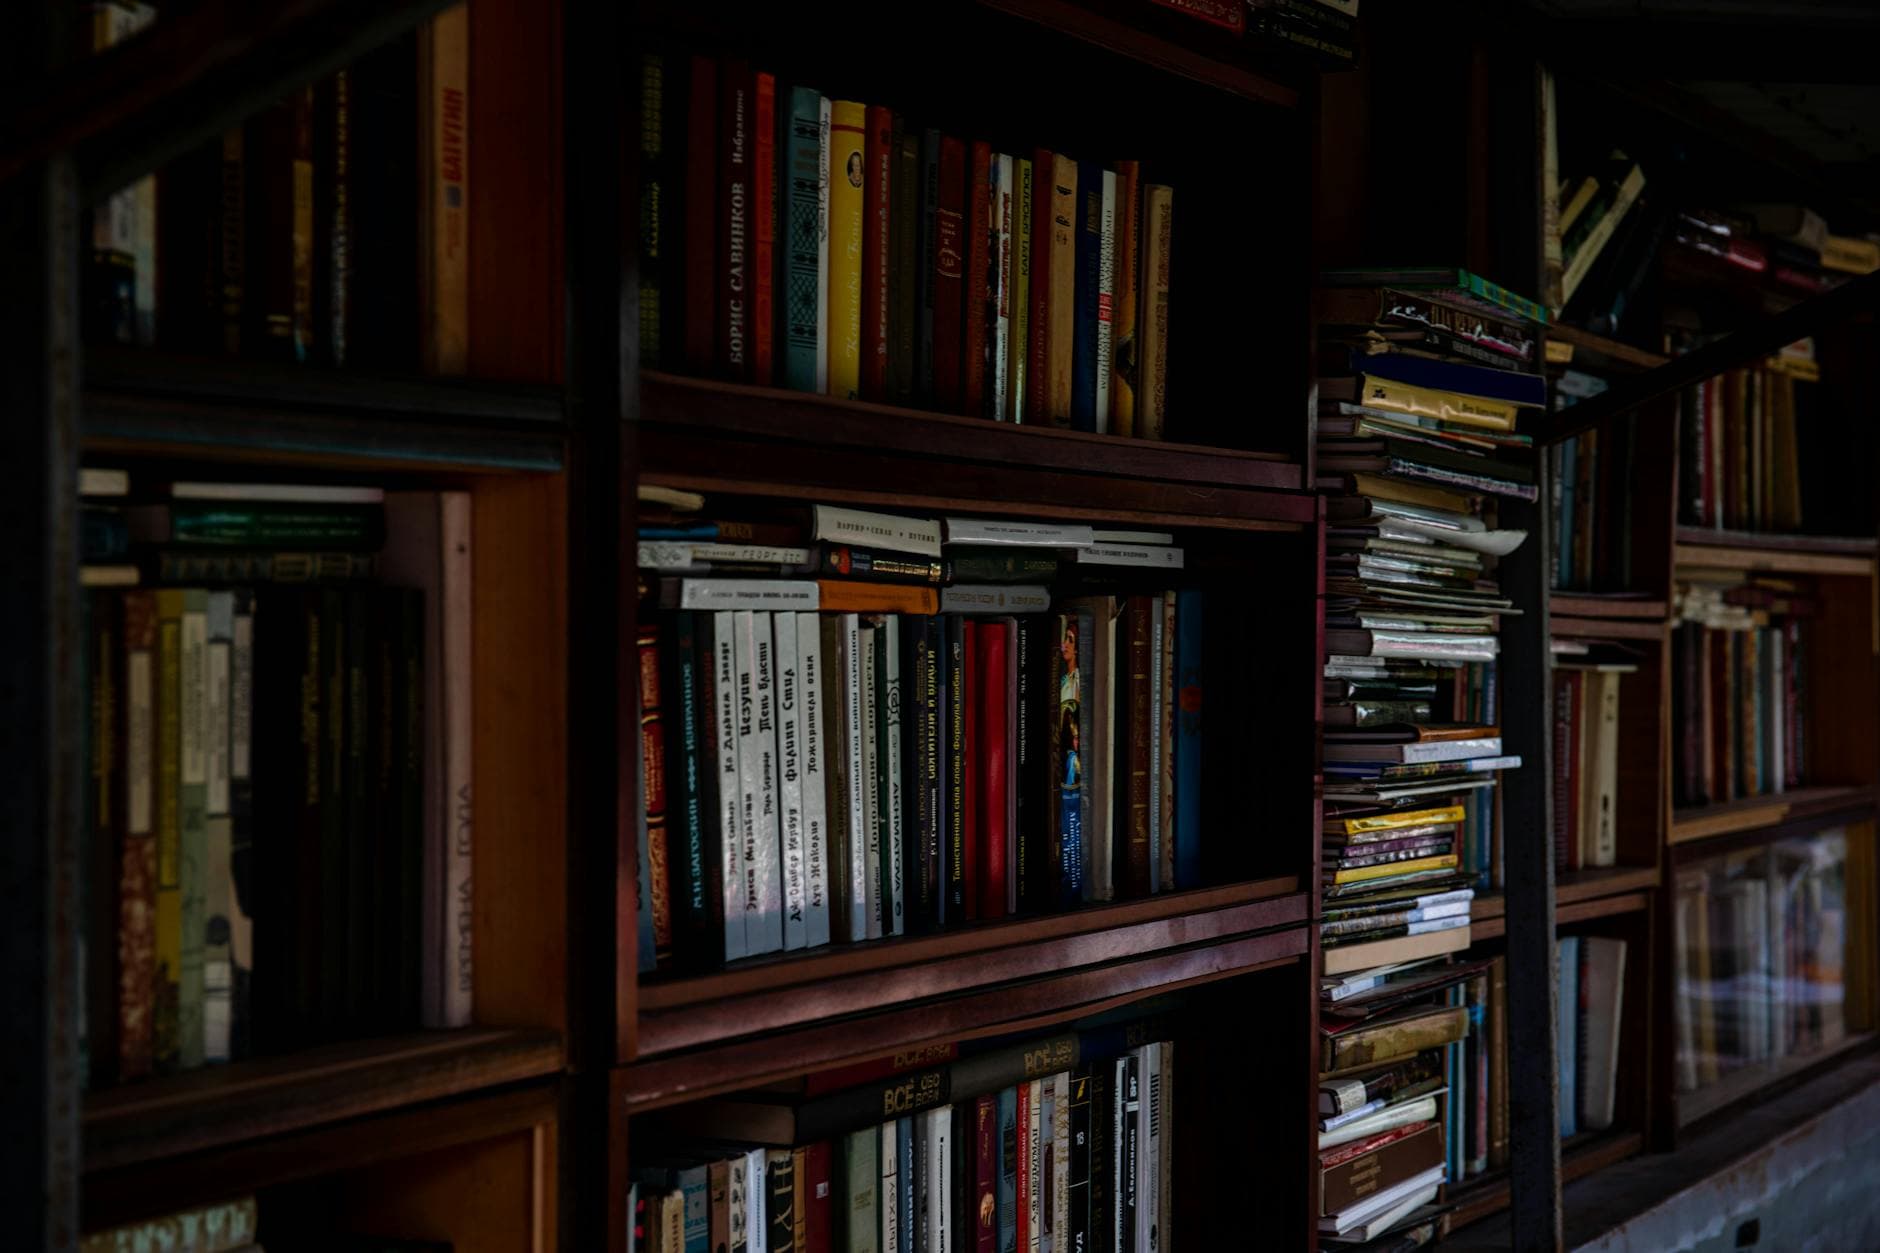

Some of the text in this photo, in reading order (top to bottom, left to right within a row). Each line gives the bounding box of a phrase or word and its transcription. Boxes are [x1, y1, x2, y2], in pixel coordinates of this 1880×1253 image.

[730, 181, 745, 292] САВИНКОВ
[1020, 167, 1031, 276] КАРЛ БРЮЛЛОВ
[728, 298, 744, 364] БОРИС
[782, 668, 795, 711] Стил
[927, 650, 936, 696] ВЛАСТИ
[951, 667, 961, 702] любви
[758, 695, 772, 733] Тень
[806, 691, 818, 775] Пожиратели
[951, 703, 962, 751] Формула
[784, 720, 798, 782] Филипп
[952, 786, 961, 810] сила
[951, 811, 961, 882] Таинственная
[888, 1181, 897, 1251] РЫТХЭУ
